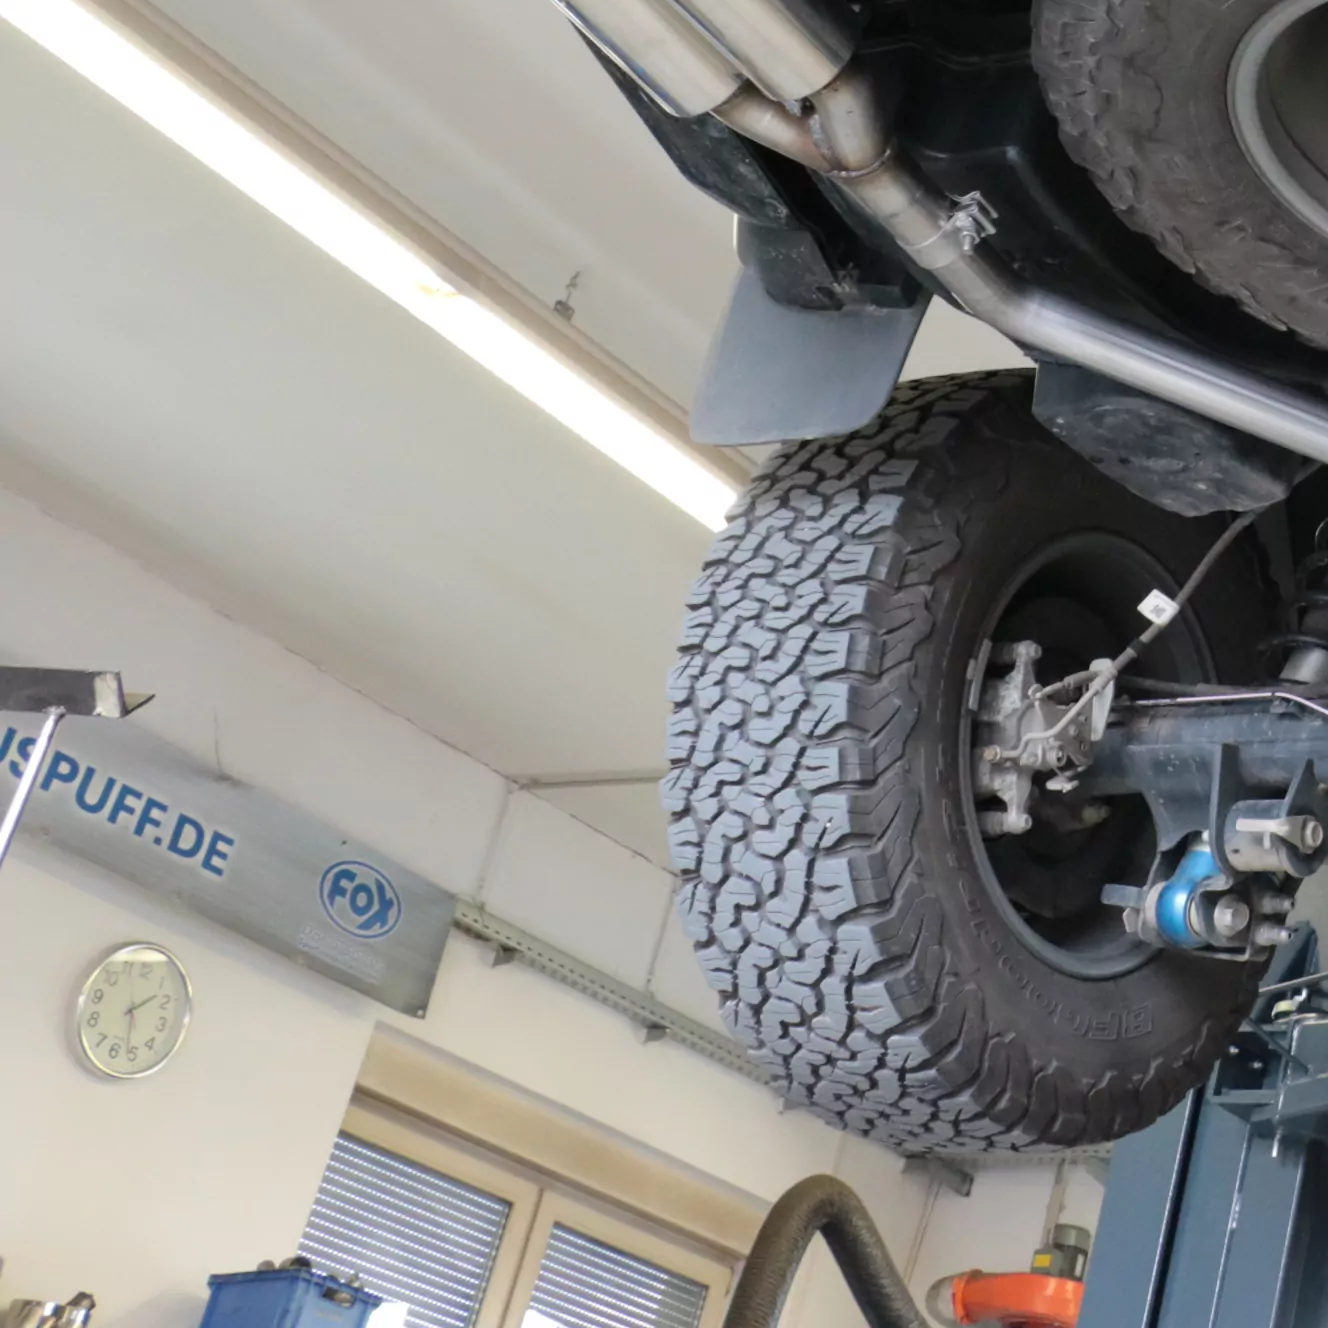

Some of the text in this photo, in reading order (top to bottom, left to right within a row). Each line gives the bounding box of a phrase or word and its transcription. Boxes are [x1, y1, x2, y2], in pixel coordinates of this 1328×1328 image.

[91, 989, 104, 1005] 9
[158, 994, 171, 1010] 2
[87, 1011, 100, 1028] 8
[155, 1016, 167, 1033] 3
[96, 1032, 108, 1048] 7
[144, 1036, 156, 1051] 4
[108, 1042, 121, 1059] 6
[126, 1046, 139, 1062] 5
